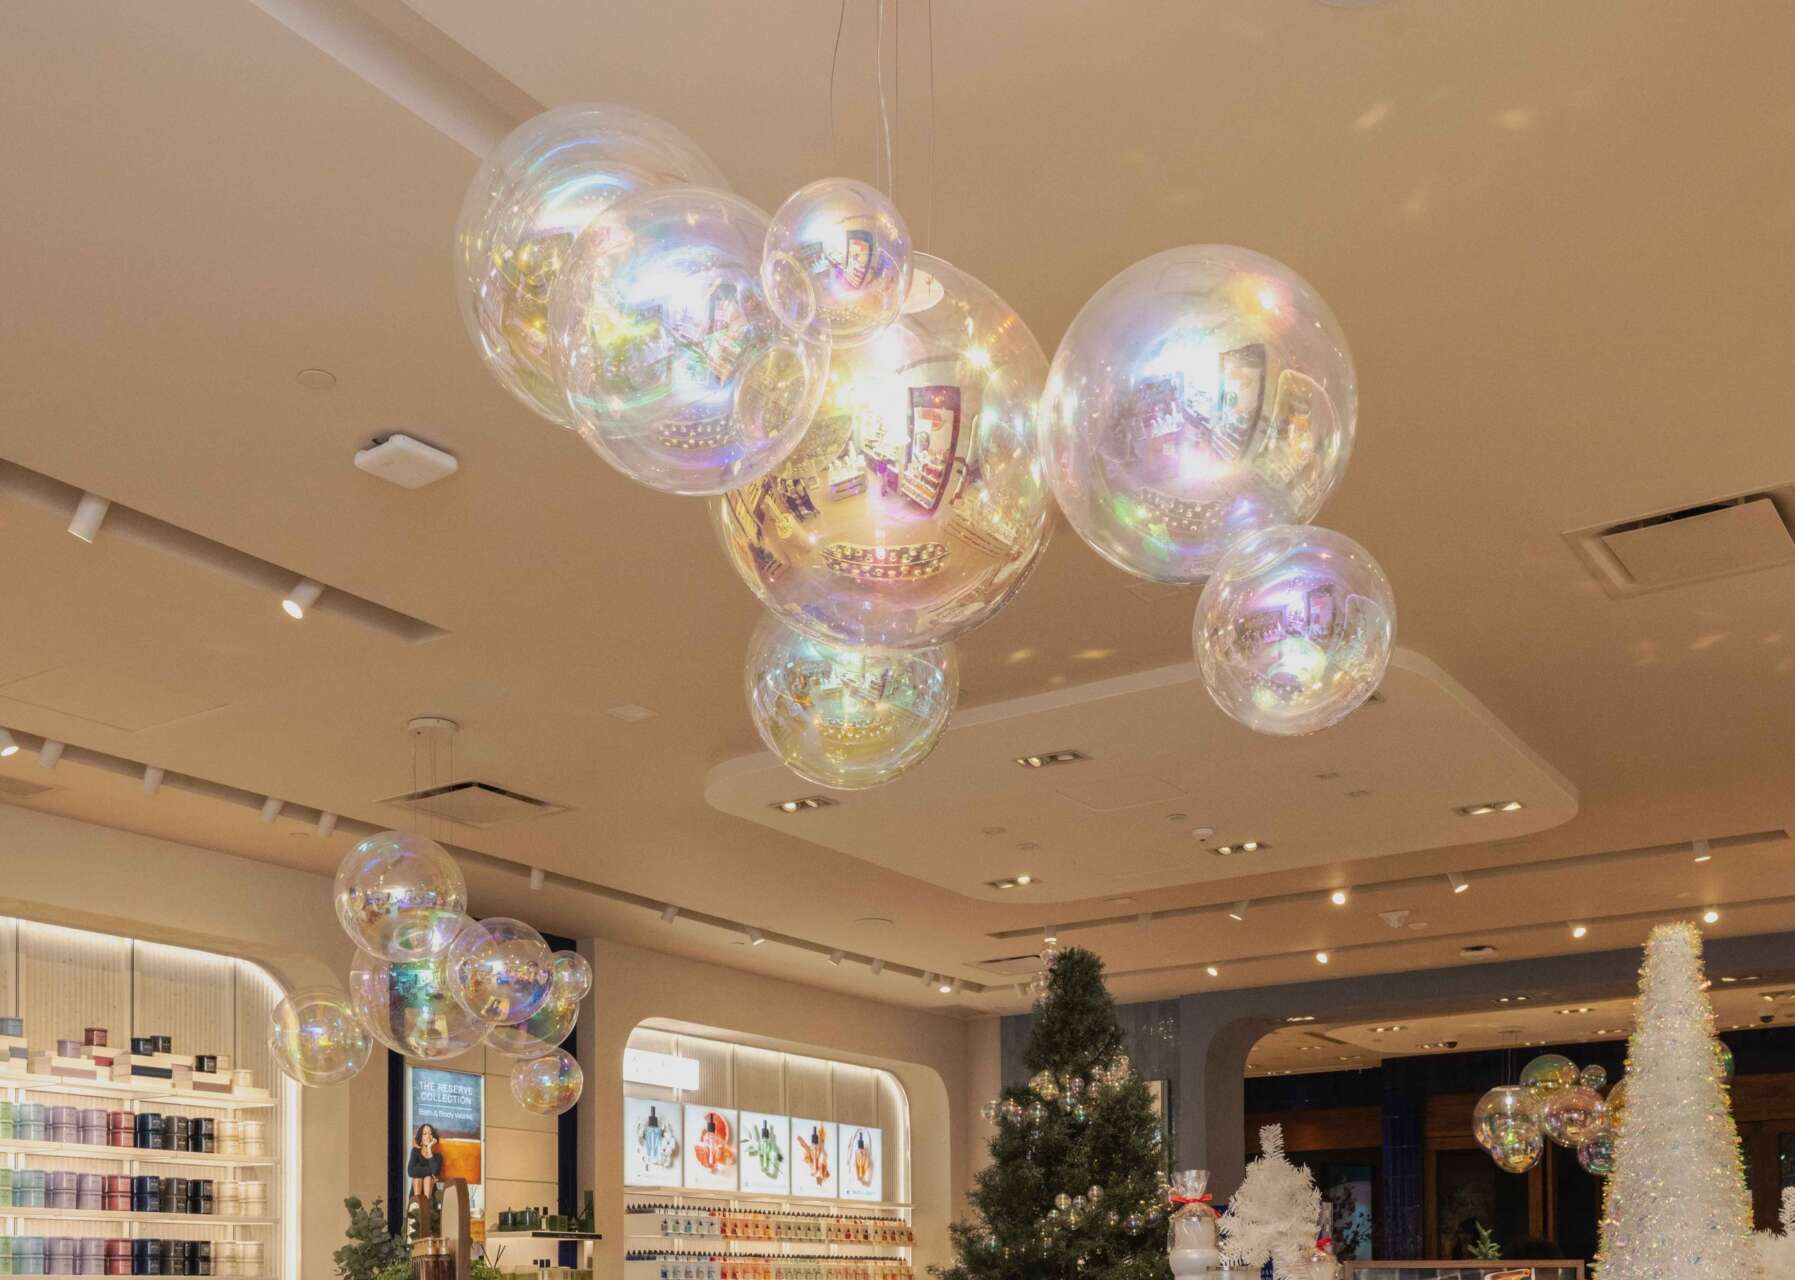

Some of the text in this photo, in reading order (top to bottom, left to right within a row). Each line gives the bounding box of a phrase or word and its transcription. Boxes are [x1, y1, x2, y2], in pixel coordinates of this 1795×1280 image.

[420, 1080, 473, 1096] THE RESERVE
[420, 1091, 472, 1105] COLLECTION
